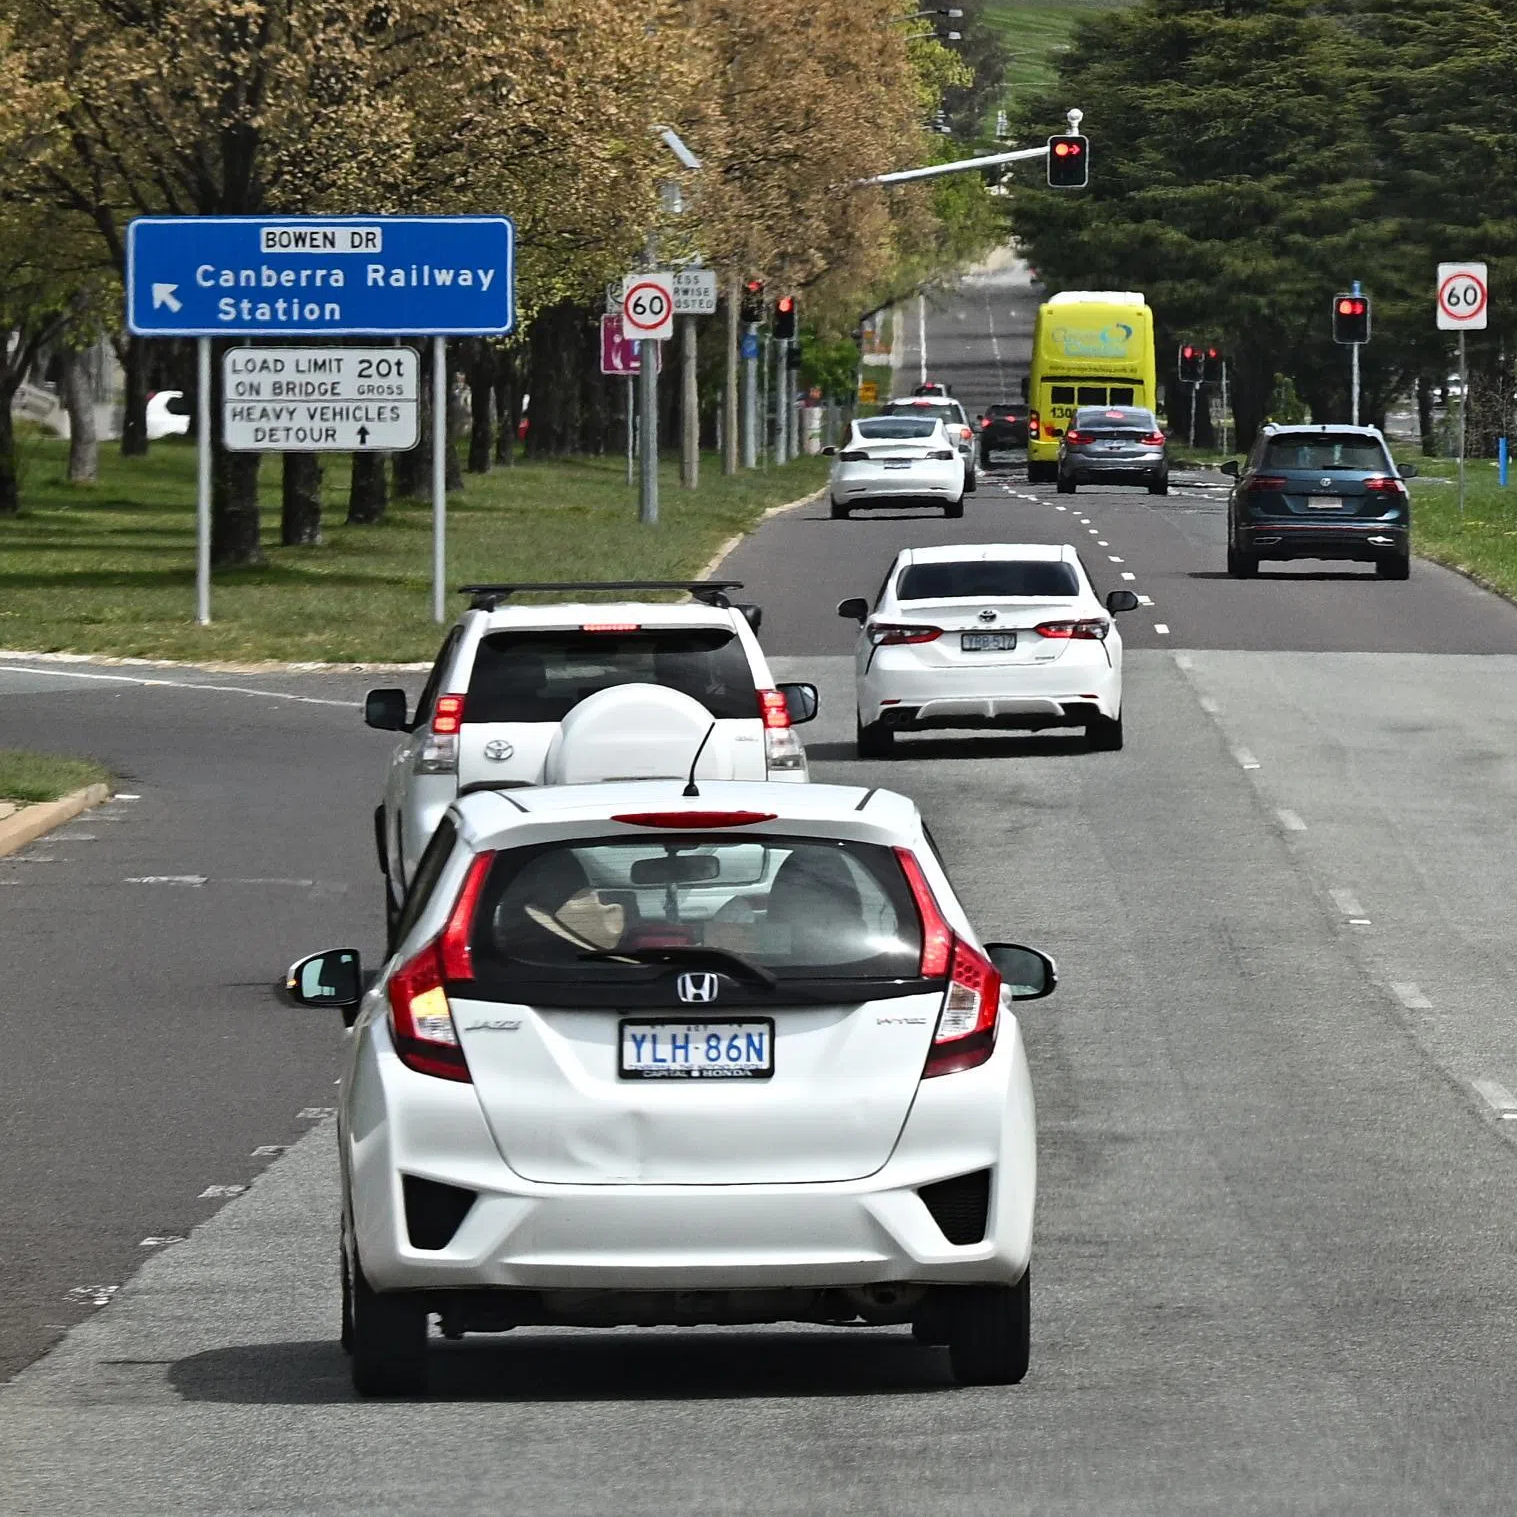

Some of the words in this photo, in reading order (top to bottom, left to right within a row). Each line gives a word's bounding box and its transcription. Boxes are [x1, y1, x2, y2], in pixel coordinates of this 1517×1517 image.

[265, 231, 336, 249] BOWEN
[350, 231, 378, 249] DR
[195, 264, 345, 288] Canberra
[366, 264, 495, 291] Railway
[1447, 284, 1478, 307] 60
[217, 297, 342, 321] Station
[633, 295, 664, 316] 60
[231, 358, 285, 374] LOAD
[295, 358, 344, 374] LIMIT
[357, 358, 404, 378] 20t
[235, 381, 261, 397] ON
[272, 381, 342, 397] BRIDGE
[357, 384, 404, 396] GROSS
[231, 406, 296, 422] HEAVY
[307, 406, 401, 422] VEHICLES
[253, 426, 337, 443] DETOUR
[642, 1069, 688, 1078] CAPITAL
[702, 1069, 753, 1077] HONDA
